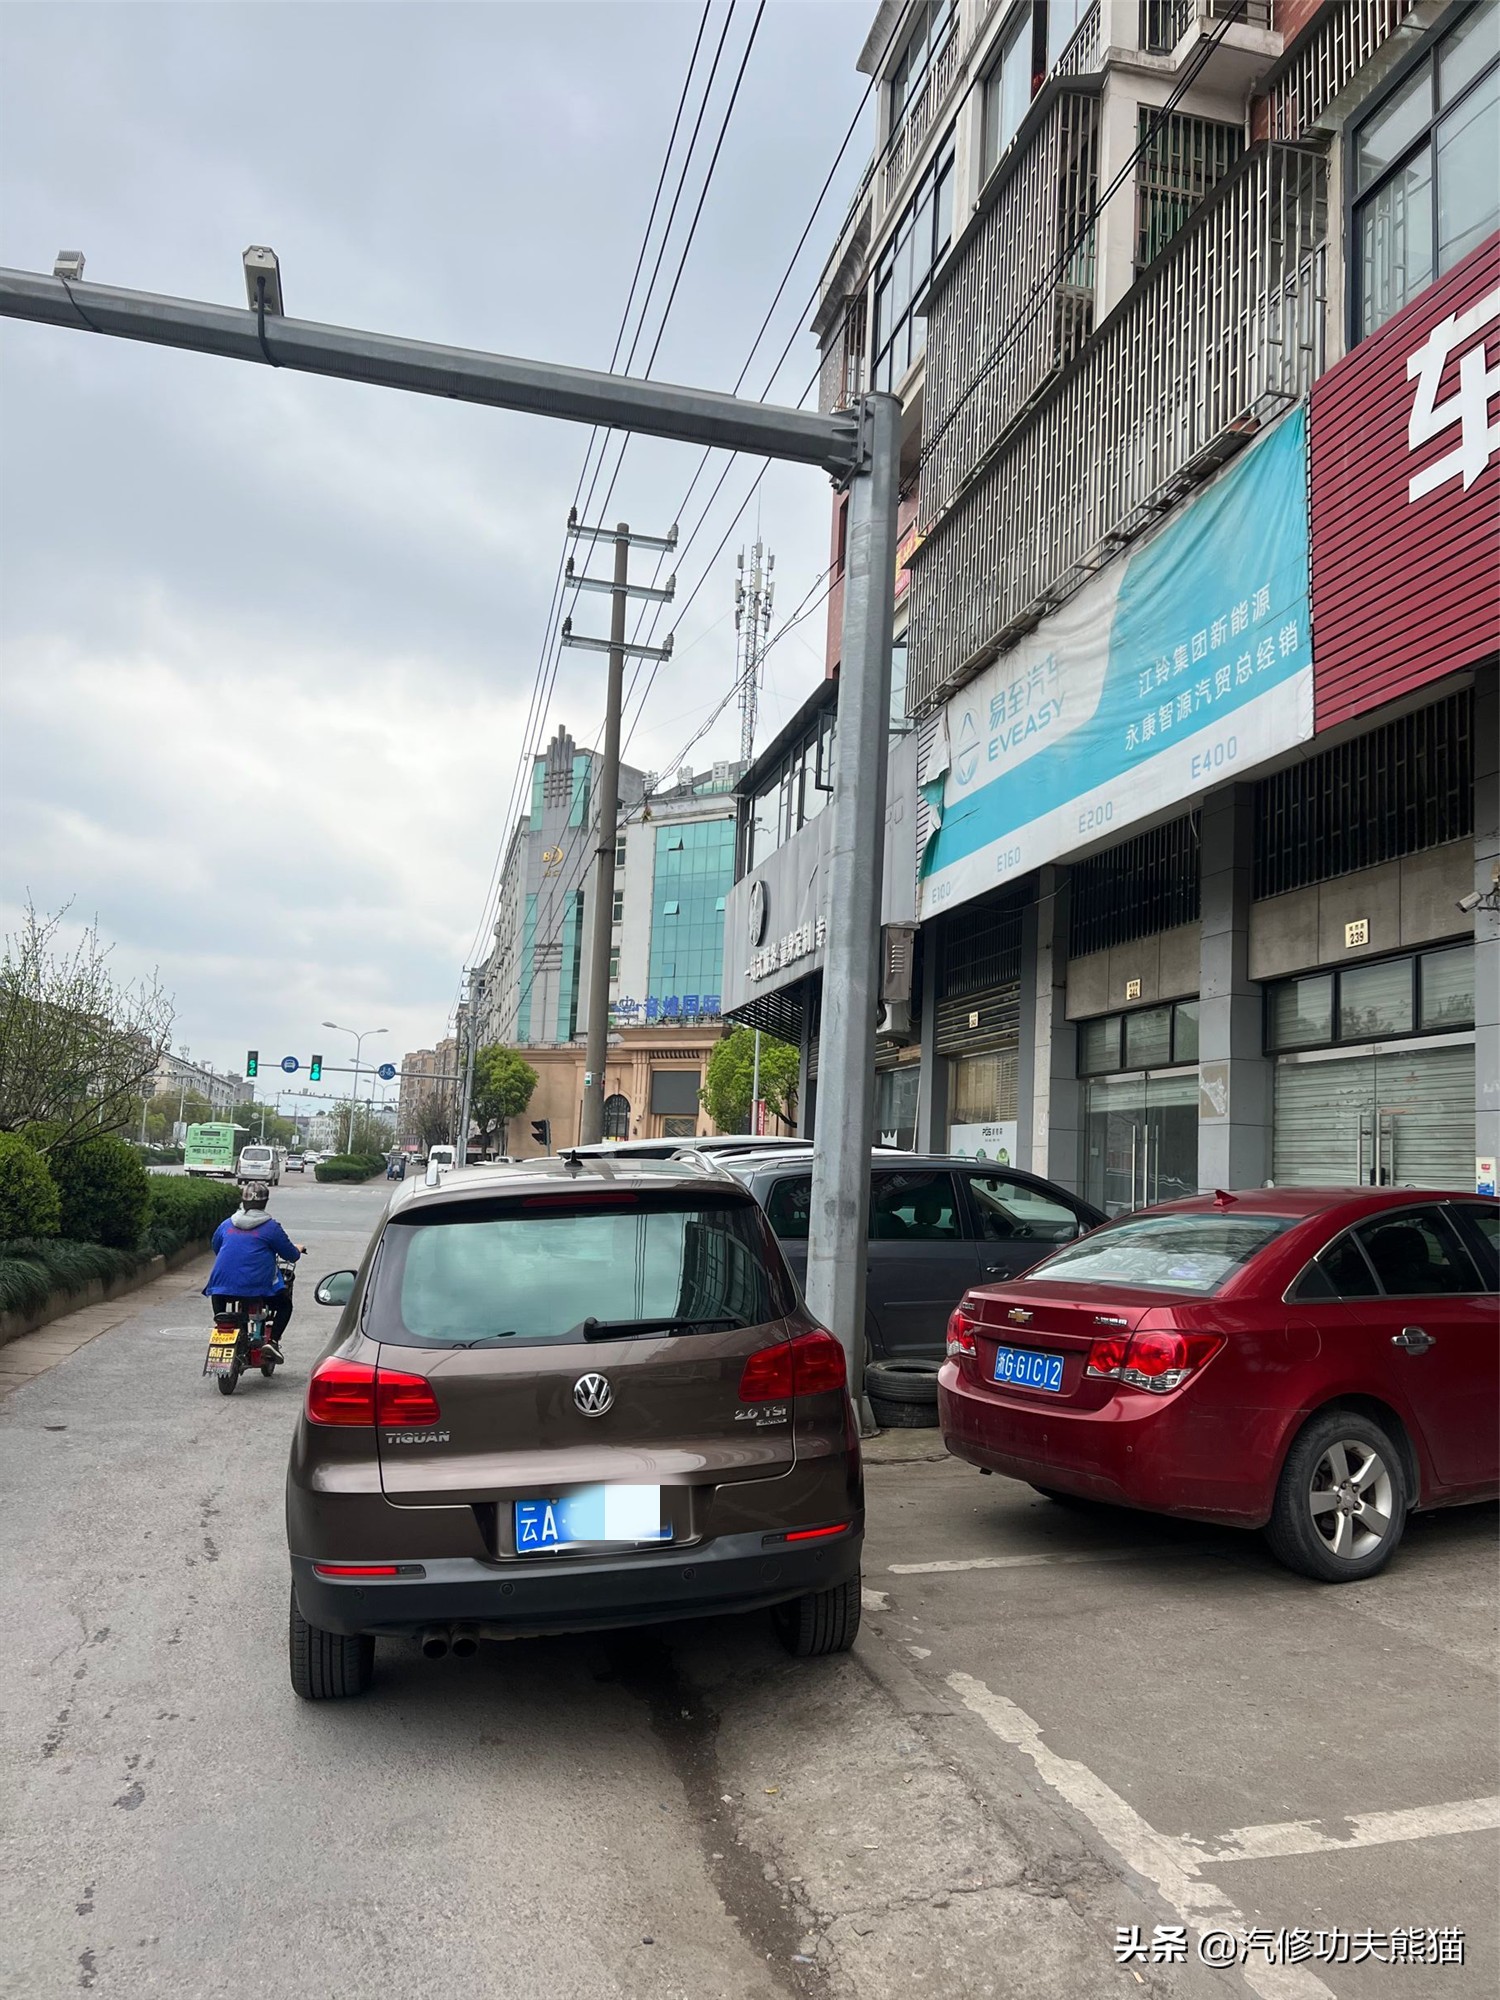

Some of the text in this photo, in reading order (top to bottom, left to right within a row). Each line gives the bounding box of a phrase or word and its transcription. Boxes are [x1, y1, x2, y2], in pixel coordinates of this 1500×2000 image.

[1139, 583, 1271, 698] 江铃集团新能源
[1125, 619, 1299, 751] 永康智源汽贸总经销
[988, 690, 1065, 762] EVEASY
[1191, 736, 1238, 779] E400
[1078, 801, 1113, 834] E200
[997, 846, 1021, 873] E160
[931, 882, 951, 904] E100
[1350, 931, 1364, 945] 239
[763, 1406, 787, 1417] TSI
[385, 1430, 451, 1444] TIGUAN
